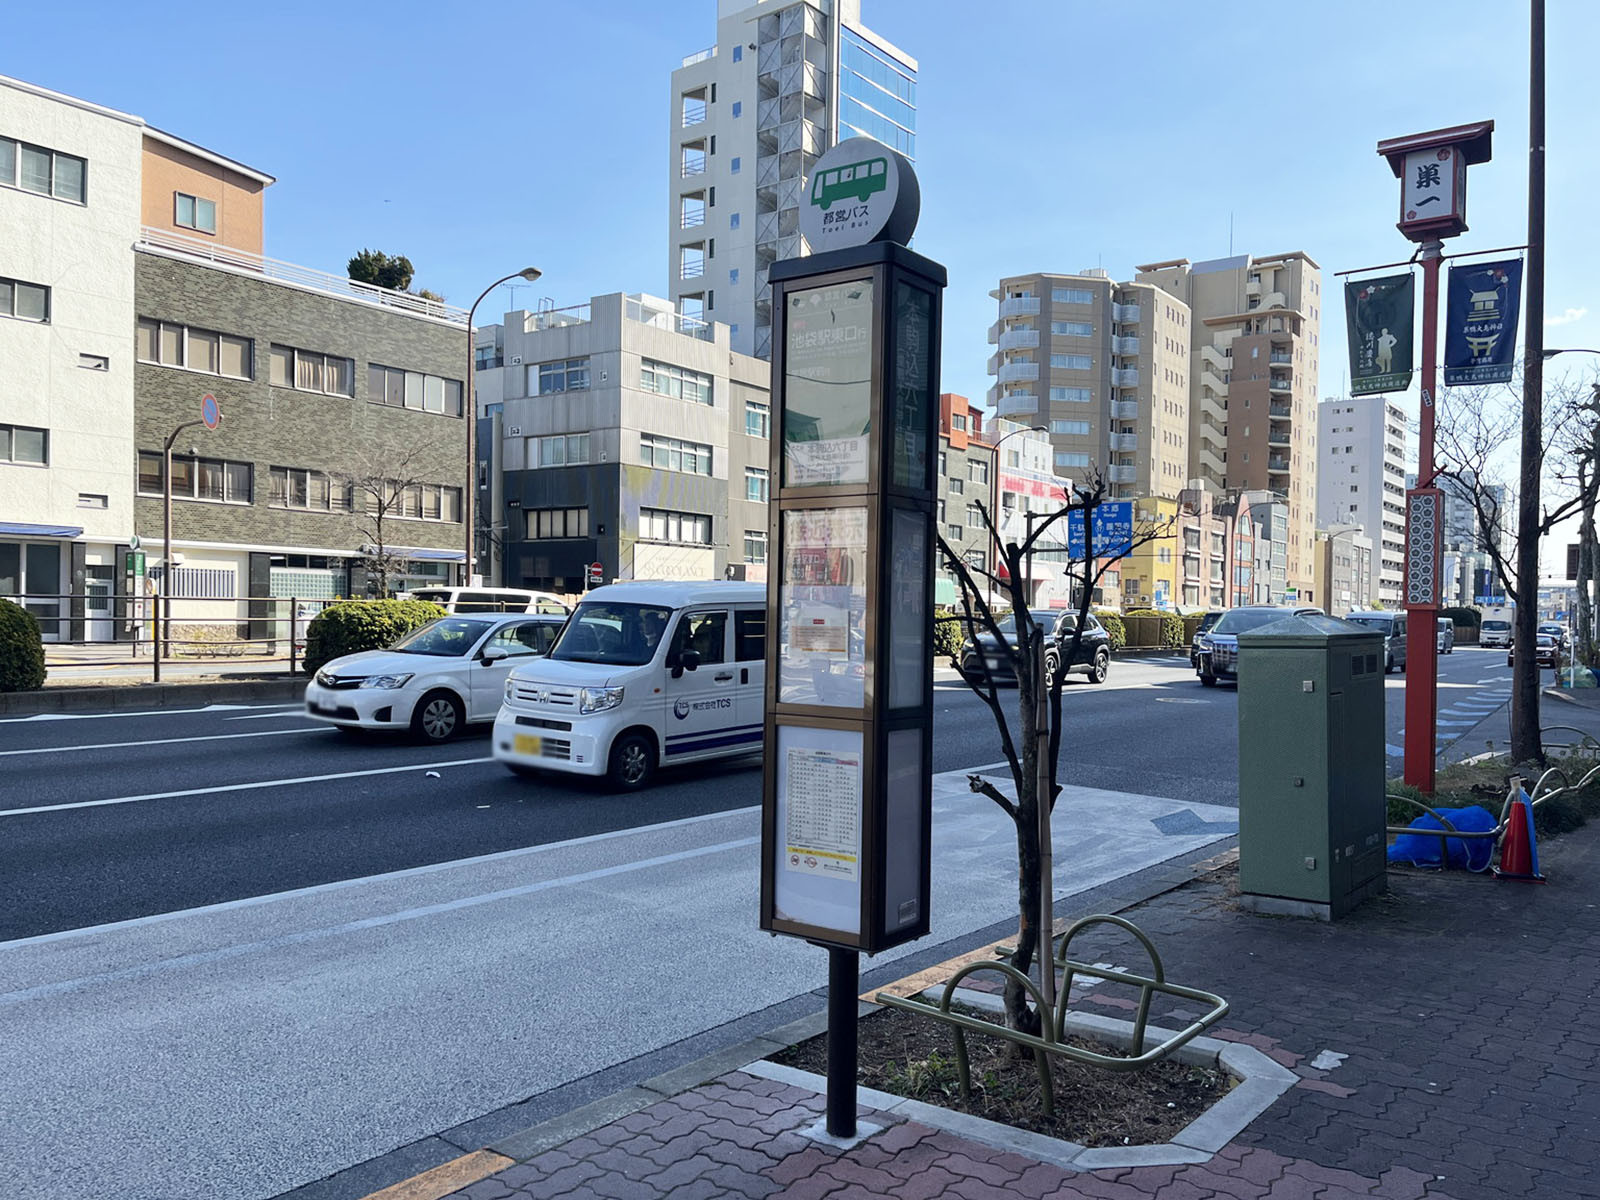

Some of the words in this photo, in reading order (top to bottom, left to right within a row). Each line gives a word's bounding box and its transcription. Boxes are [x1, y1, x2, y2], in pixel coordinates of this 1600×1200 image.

[823, 205, 869, 225] 都営バス
[903, 301, 921, 456] 本駒込六丁目
